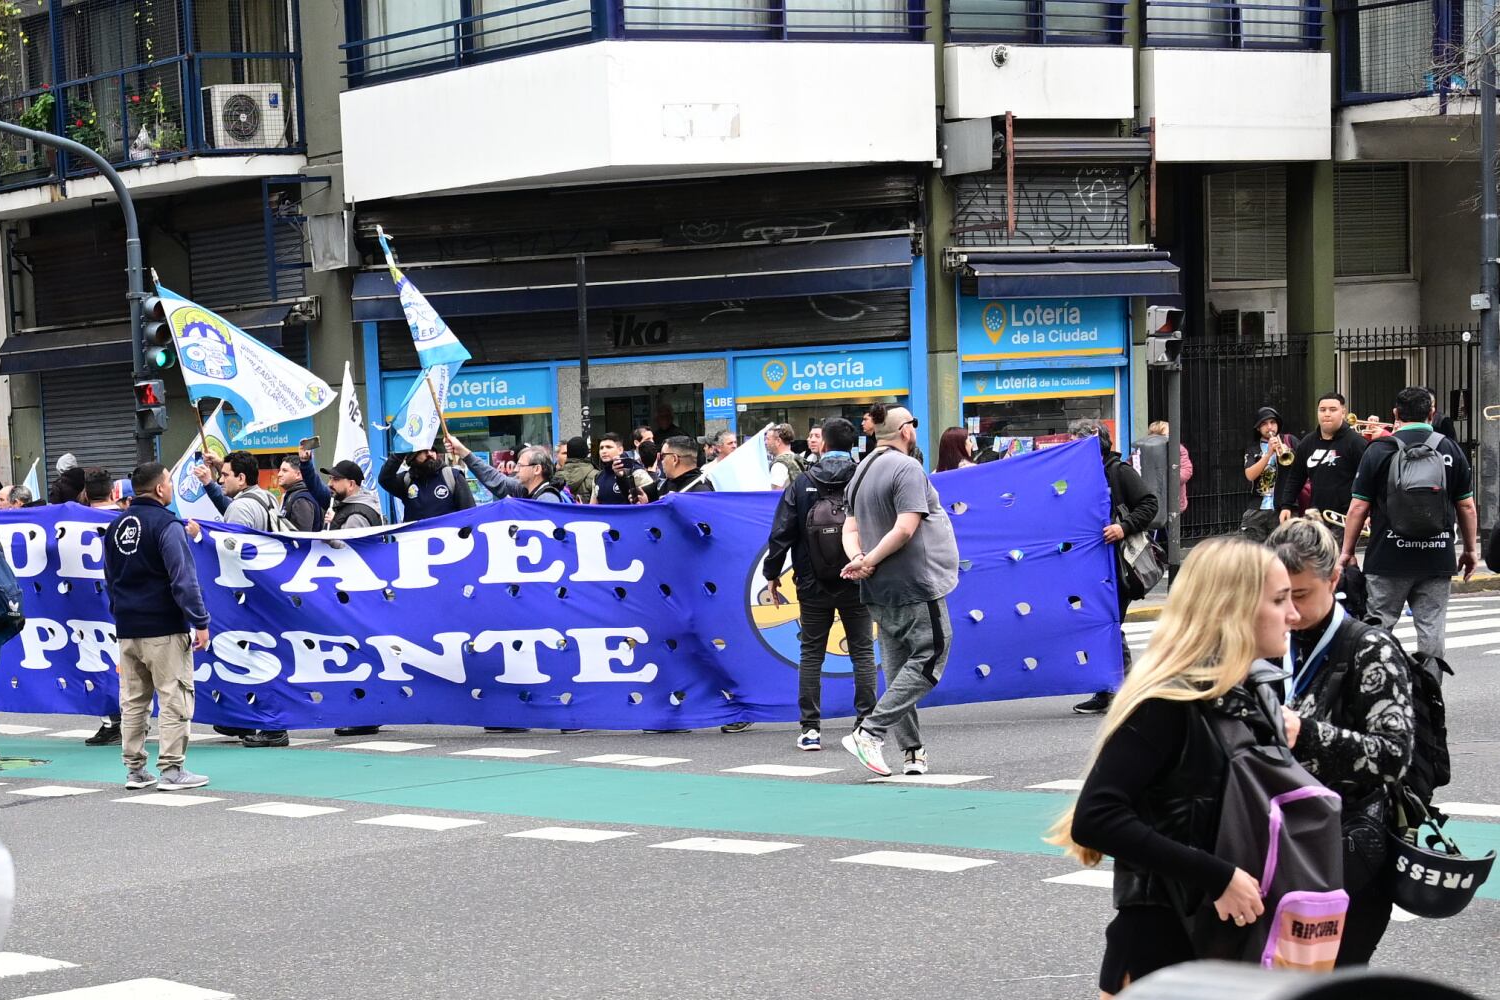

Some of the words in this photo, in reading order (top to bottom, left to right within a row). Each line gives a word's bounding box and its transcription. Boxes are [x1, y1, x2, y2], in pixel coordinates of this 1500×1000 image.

[1011, 302, 1081, 326] Lotería
[1011, 330, 1029, 344] de
[1032, 330, 1045, 343] la
[1048, 327, 1098, 343] Ciudad
[791, 357, 864, 378] Lotería
[447, 376, 509, 397] otería
[792, 380, 811, 391] de
[814, 379, 827, 390] la
[830, 376, 883, 389] Ciudad
[995, 374, 1038, 389] Lotería
[1039, 379, 1050, 388] de
[1051, 378, 1059, 387] la
[1060, 376, 1090, 386] Ciudad
[460, 398, 473, 408] la
[475, 395, 526, 408] Ciudad
[706, 396, 733, 408] SUBE
[261, 434, 289, 445] Ciudad
[1396, 539, 1447, 550] Campana
[209, 519, 645, 593] PAPEL
[19, 617, 658, 686] PRSENTE
[1396, 854, 1475, 890] PRESS
